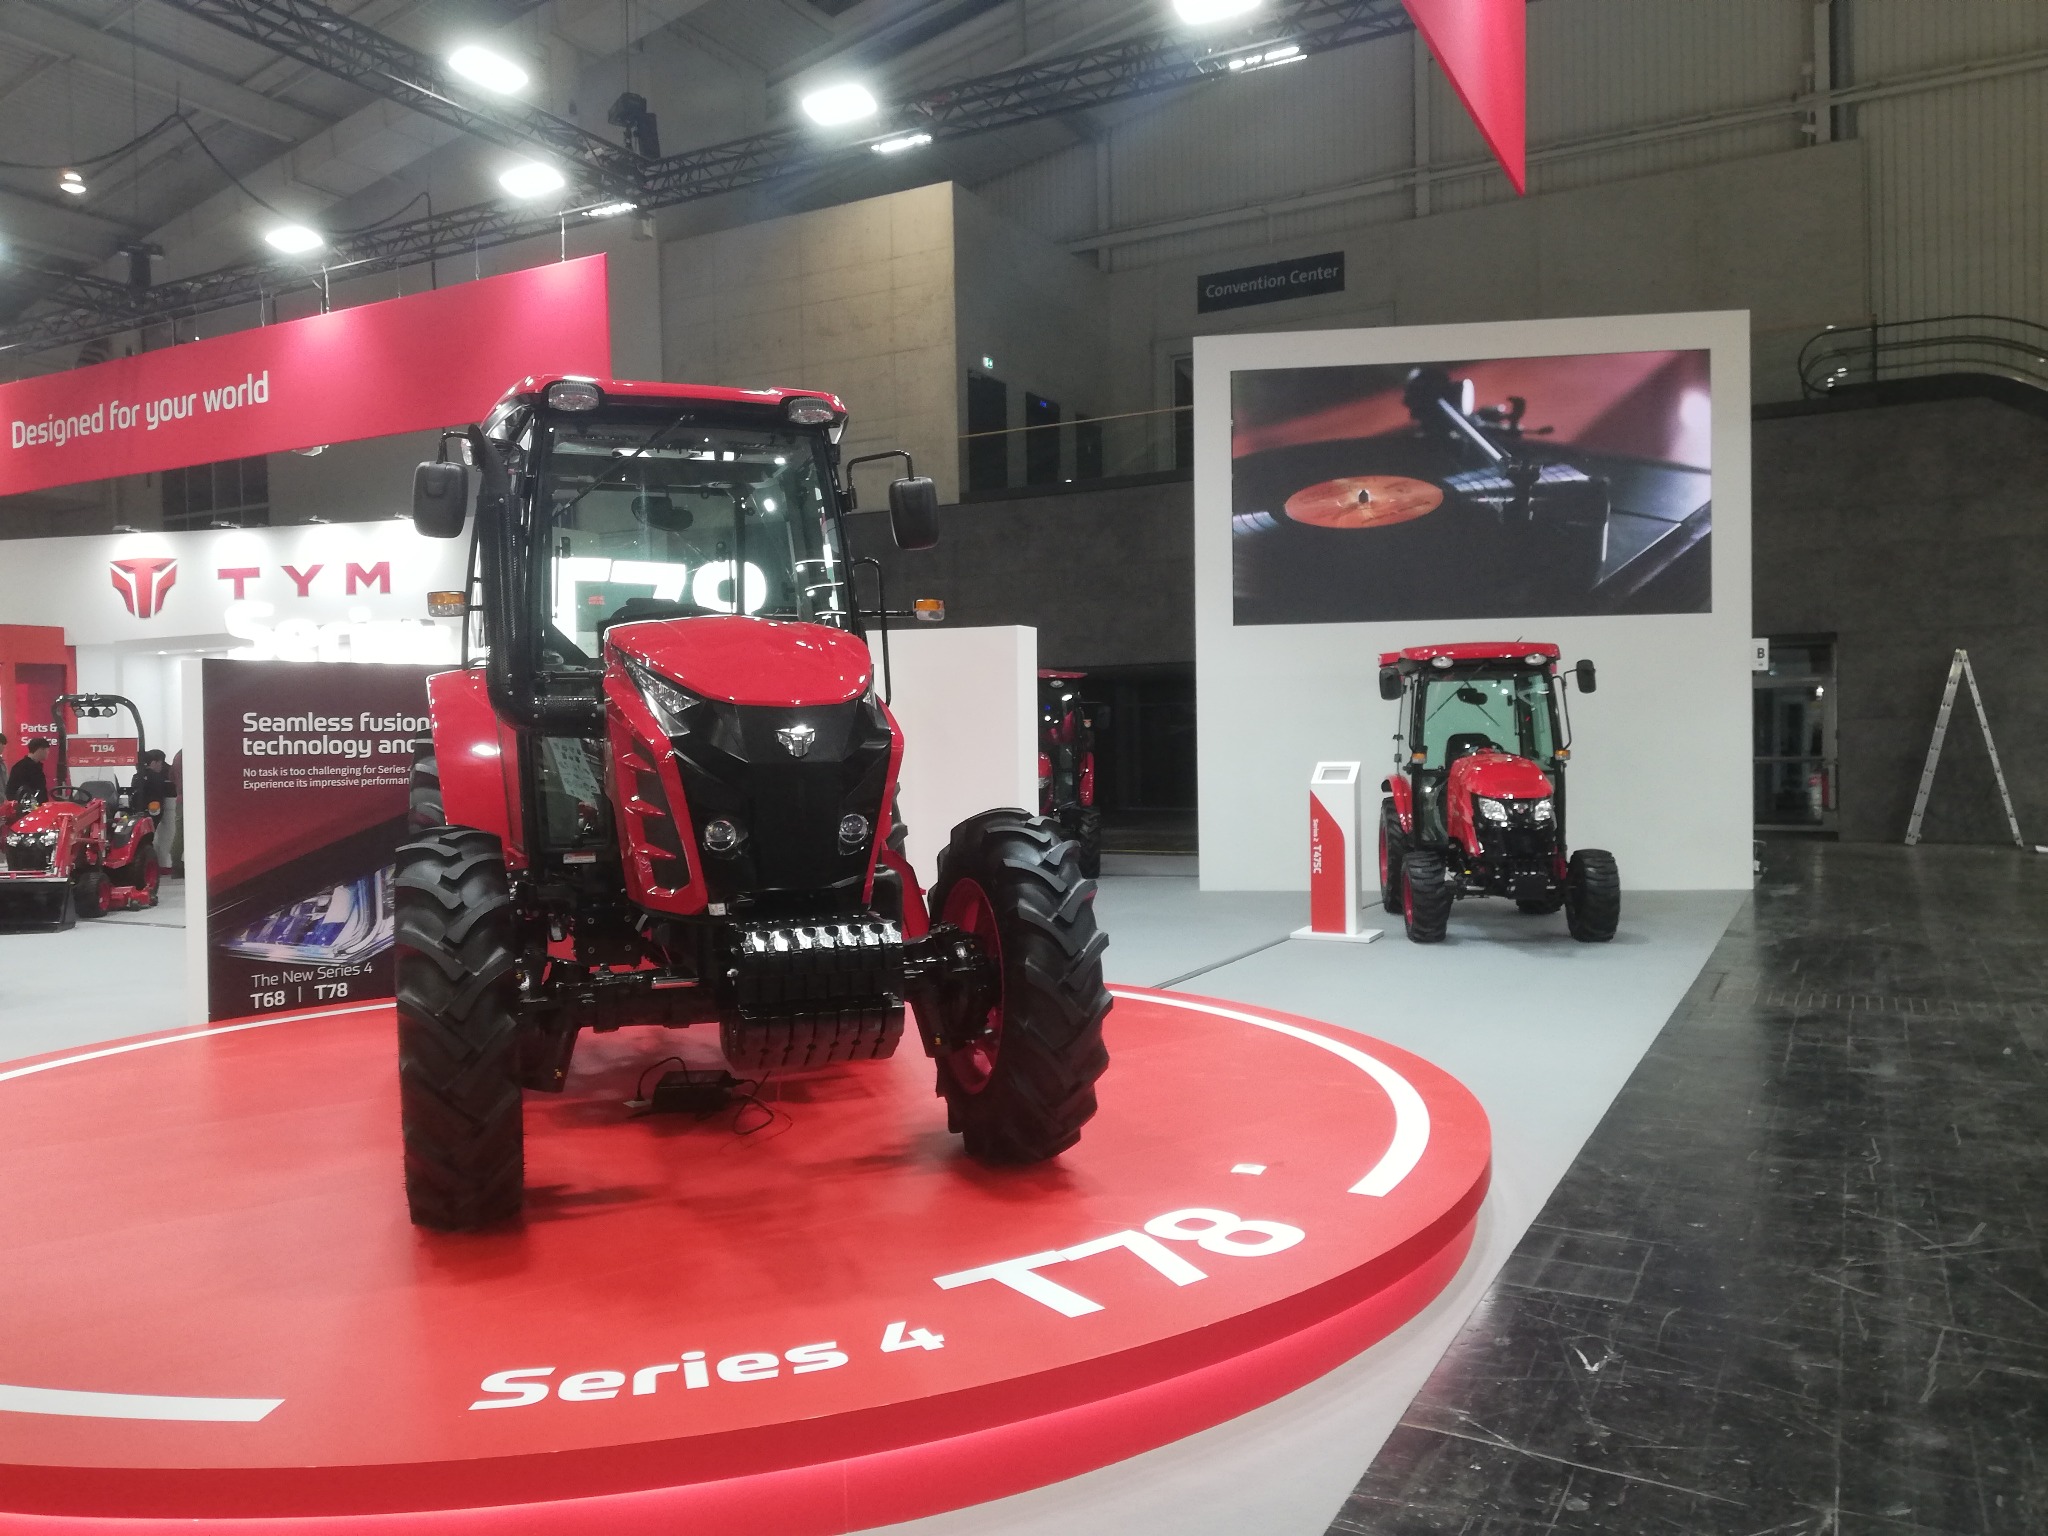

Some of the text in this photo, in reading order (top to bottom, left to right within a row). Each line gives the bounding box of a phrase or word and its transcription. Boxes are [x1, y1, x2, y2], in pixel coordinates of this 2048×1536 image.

[1206, 266, 1339, 298] Convention Center
[12, 370, 269, 449] Designed for your world
[217, 561, 391, 600] TYM
[1757, 647, 1765, 659] B
[20, 723, 48, 733] Parts
[243, 712, 430, 732] Seamless fusion
[90, 744, 115, 753] T194
[243, 735, 372, 758] technology
[243, 768, 257, 777] No
[258, 767, 279, 777] task
[280, 767, 288, 776] is
[289, 766, 306, 776] too
[307, 765, 361, 777] challenging
[363, 765, 376, 774] for
[377, 765, 406, 775] Series
[243, 777, 410, 791] Experience its impressive performan
[251, 962, 373, 988] The New Series 4
[250, 982, 348, 1009] T68 T78
[468, 1208, 1306, 1411] Series 4 T78
